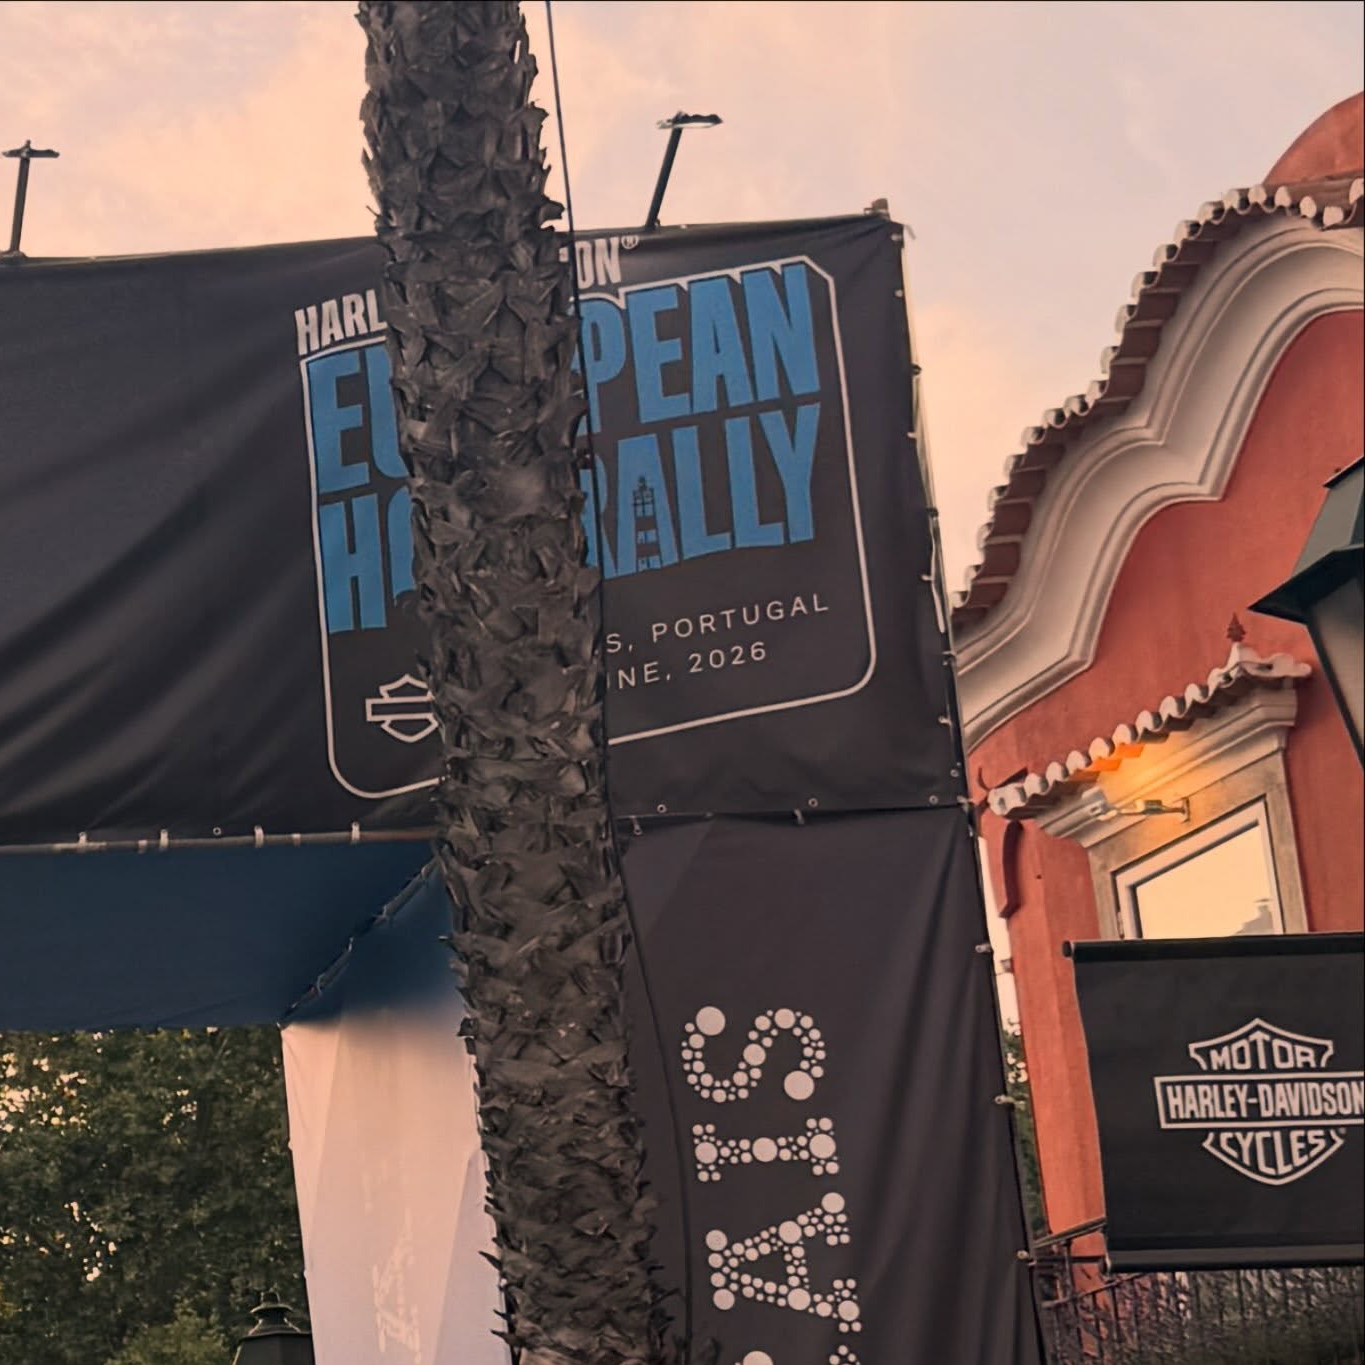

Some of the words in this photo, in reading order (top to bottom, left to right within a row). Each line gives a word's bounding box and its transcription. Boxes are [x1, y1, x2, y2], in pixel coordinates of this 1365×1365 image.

[306, 262, 821, 494] EUPEAN
[652, 594, 829, 644] PORTUGAL
[689, 642, 767, 675] 2026
[1210, 1030, 1317, 1070] MOTOR
[1167, 1081, 1364, 1119] HARLEY-DAVIDSON
[1220, 1130, 1326, 1175] CYCLES
